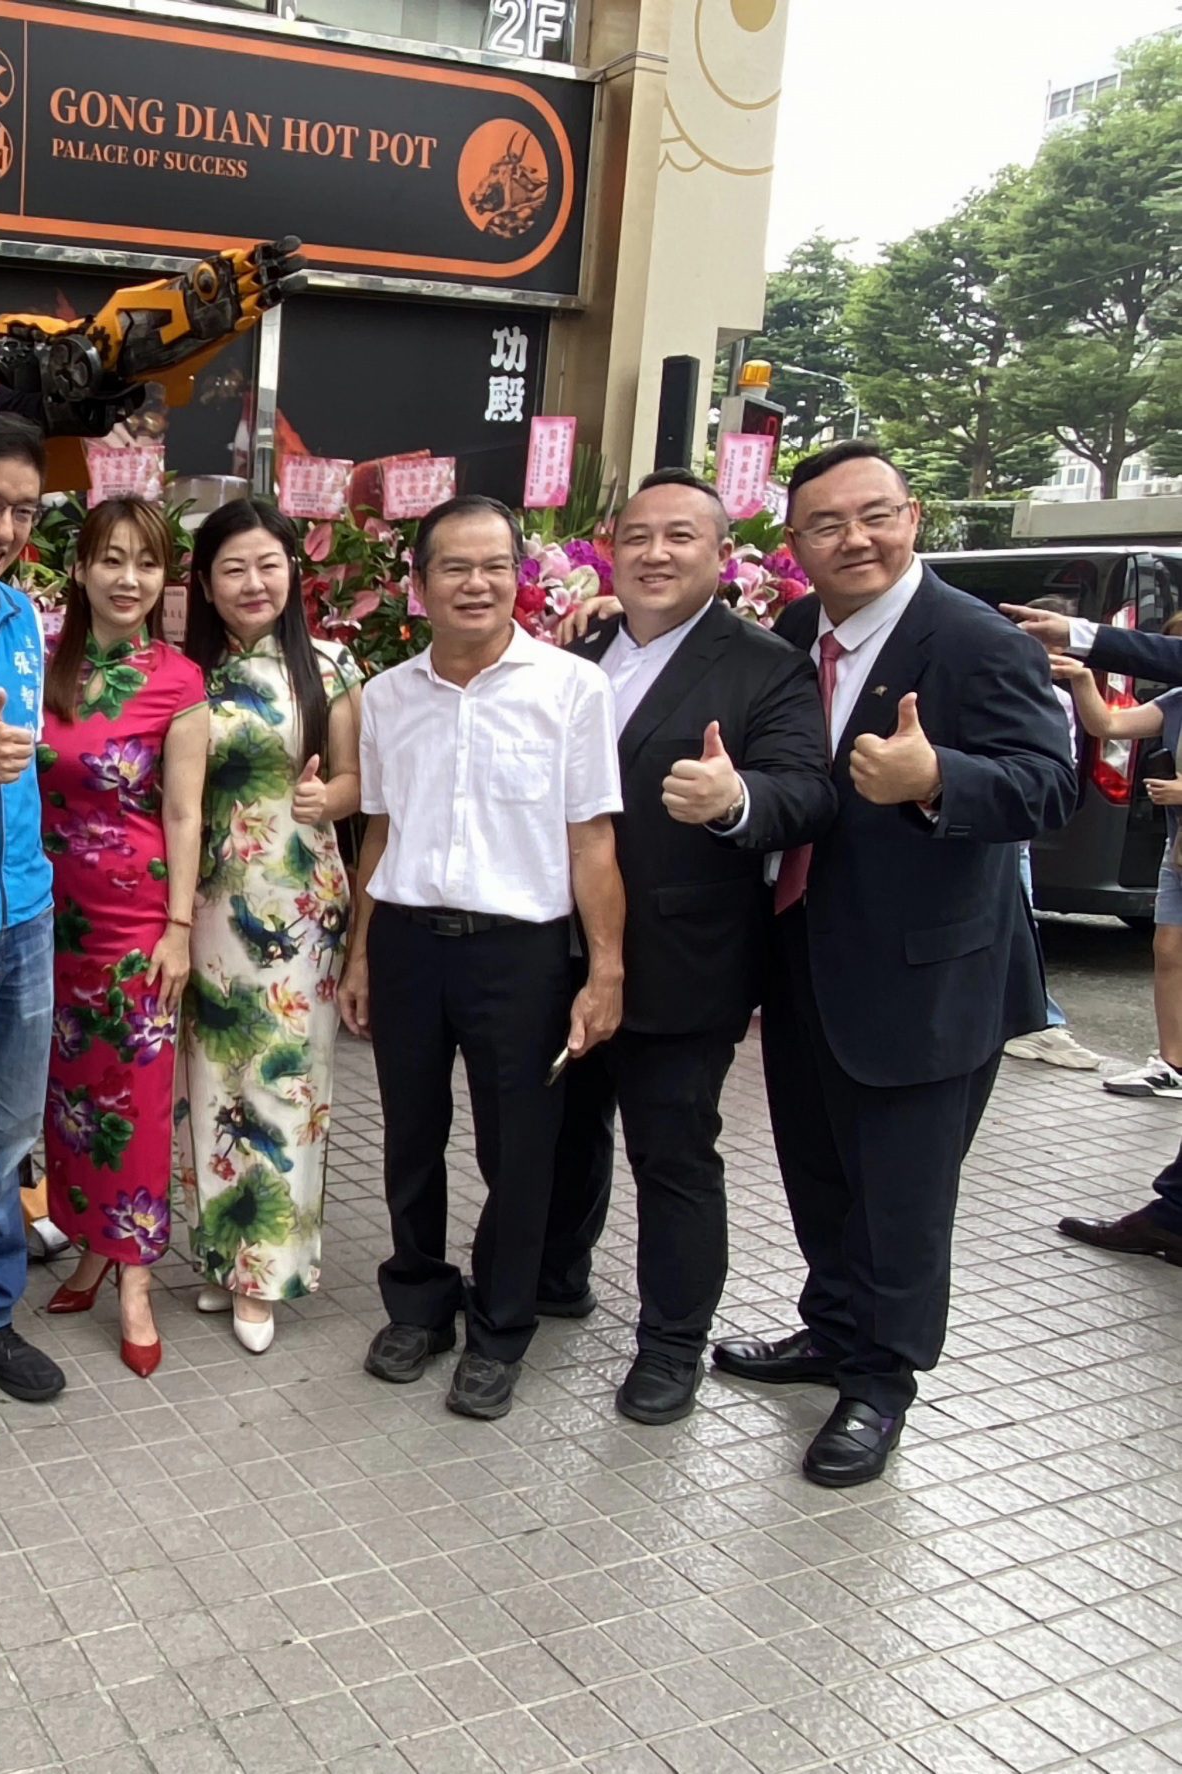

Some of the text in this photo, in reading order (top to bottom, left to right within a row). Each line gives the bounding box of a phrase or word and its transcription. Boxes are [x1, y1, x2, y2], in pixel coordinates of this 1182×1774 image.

[489, 0, 566, 58] 2F
[50, 87, 437, 169] GONG DIAN HOT POT
[52, 138, 248, 179] PALACE OF SUCCESS
[484, 326, 528, 423] 功殿
